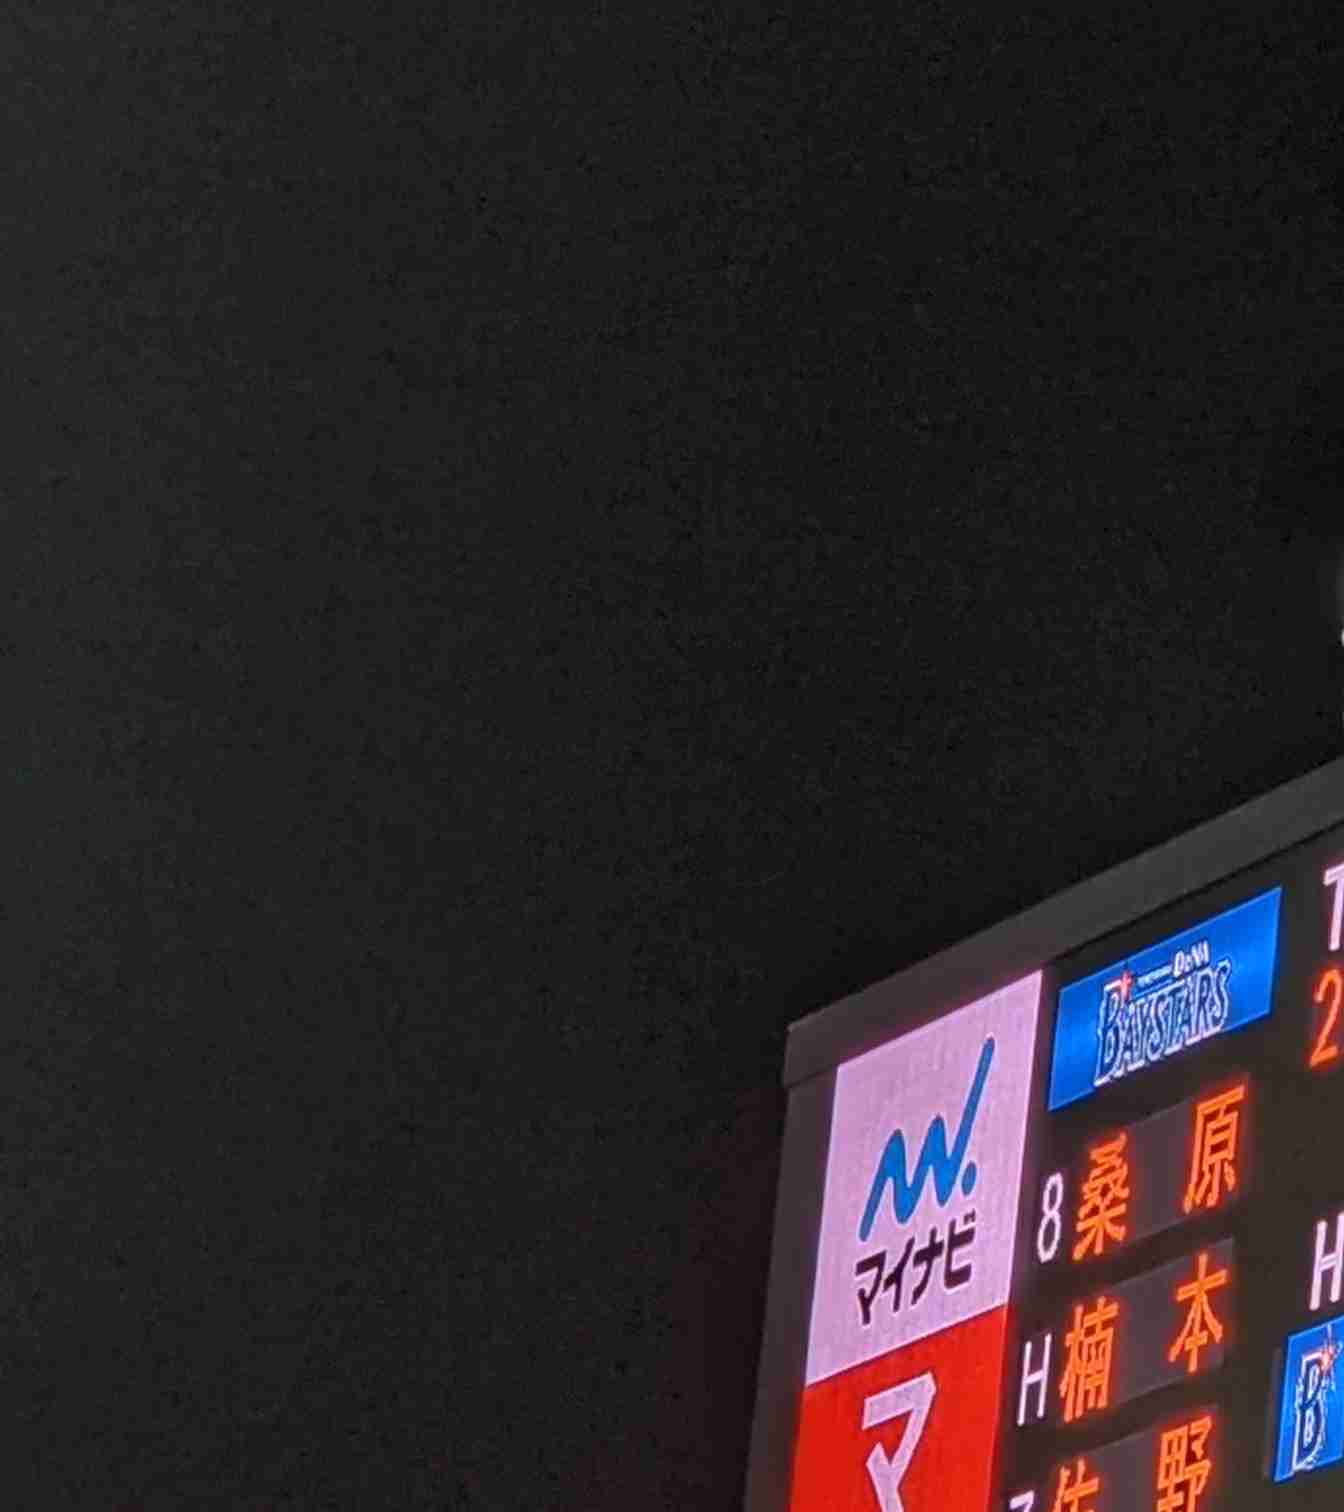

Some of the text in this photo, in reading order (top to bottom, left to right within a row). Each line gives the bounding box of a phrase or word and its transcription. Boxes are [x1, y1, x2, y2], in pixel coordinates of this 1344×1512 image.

[1093, 955, 1232, 1087] BAYSTARS
[856, 1211, 976, 1326] マイナビ
[1036, 1171, 1063, 1264] 8
[1017, 1331, 1052, 1426] H
